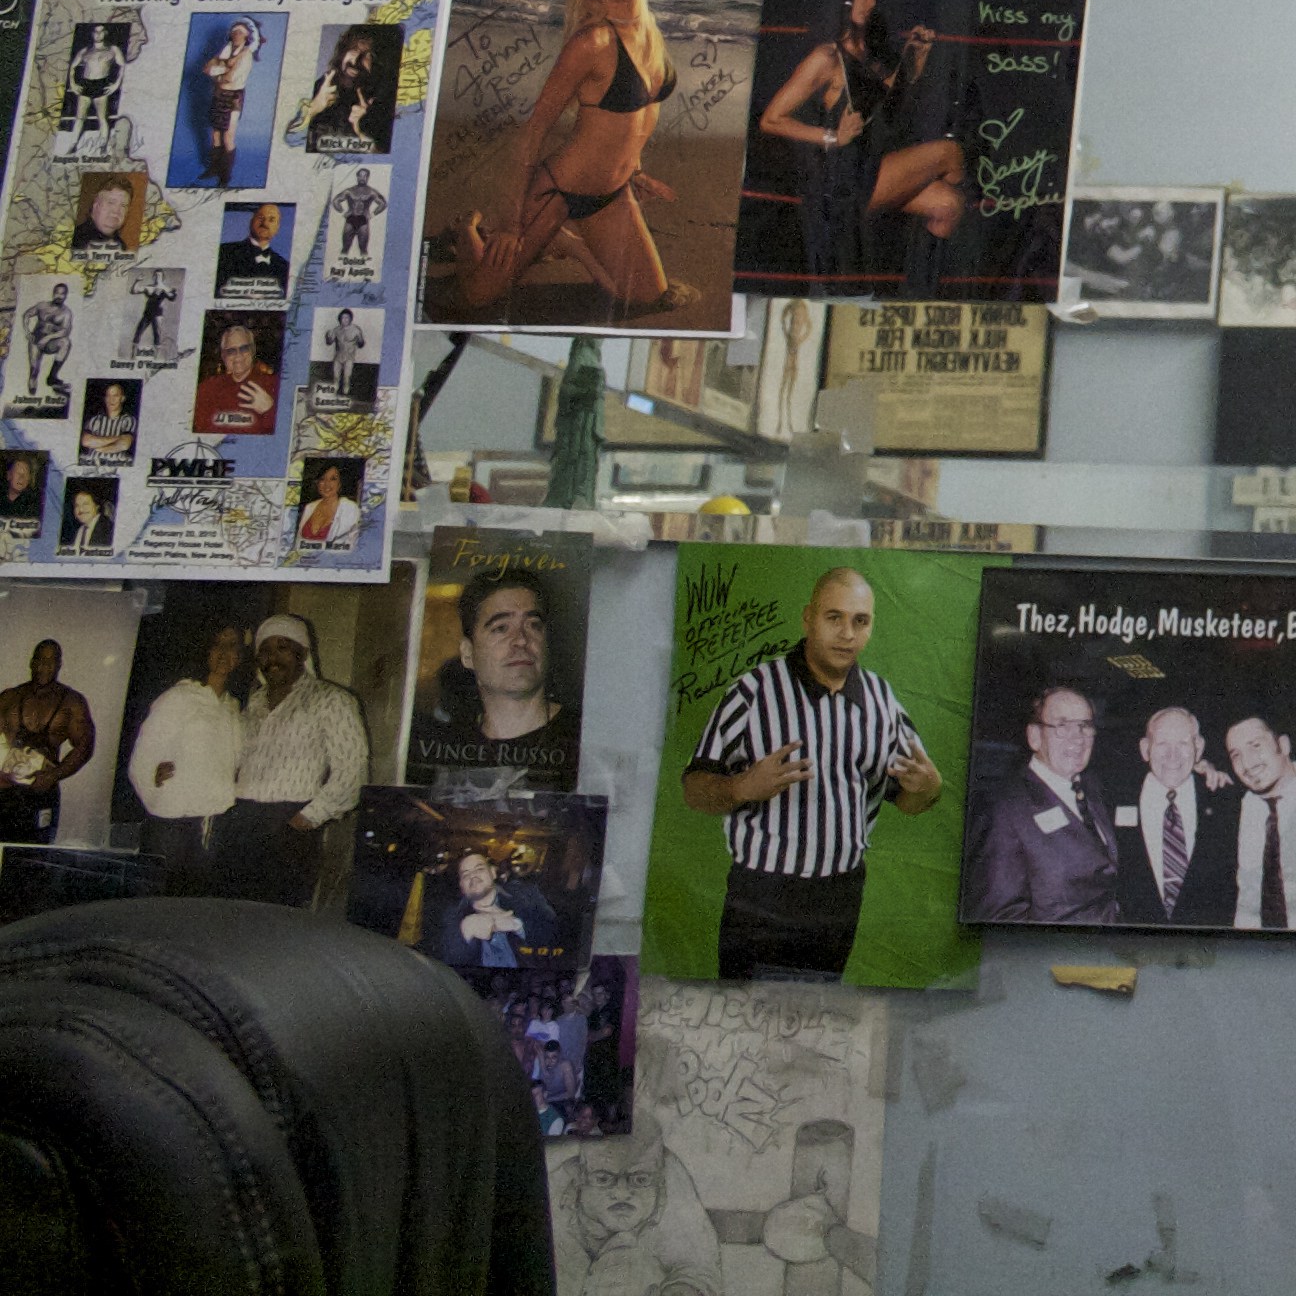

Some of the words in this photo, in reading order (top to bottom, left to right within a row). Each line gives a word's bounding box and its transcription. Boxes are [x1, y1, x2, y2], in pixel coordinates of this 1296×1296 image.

[1041, 12, 1076, 42] my
[150, 457, 237, 478] PWHF
[452, 538, 568, 581] Forgiven
[685, 561, 740, 624] WUW
